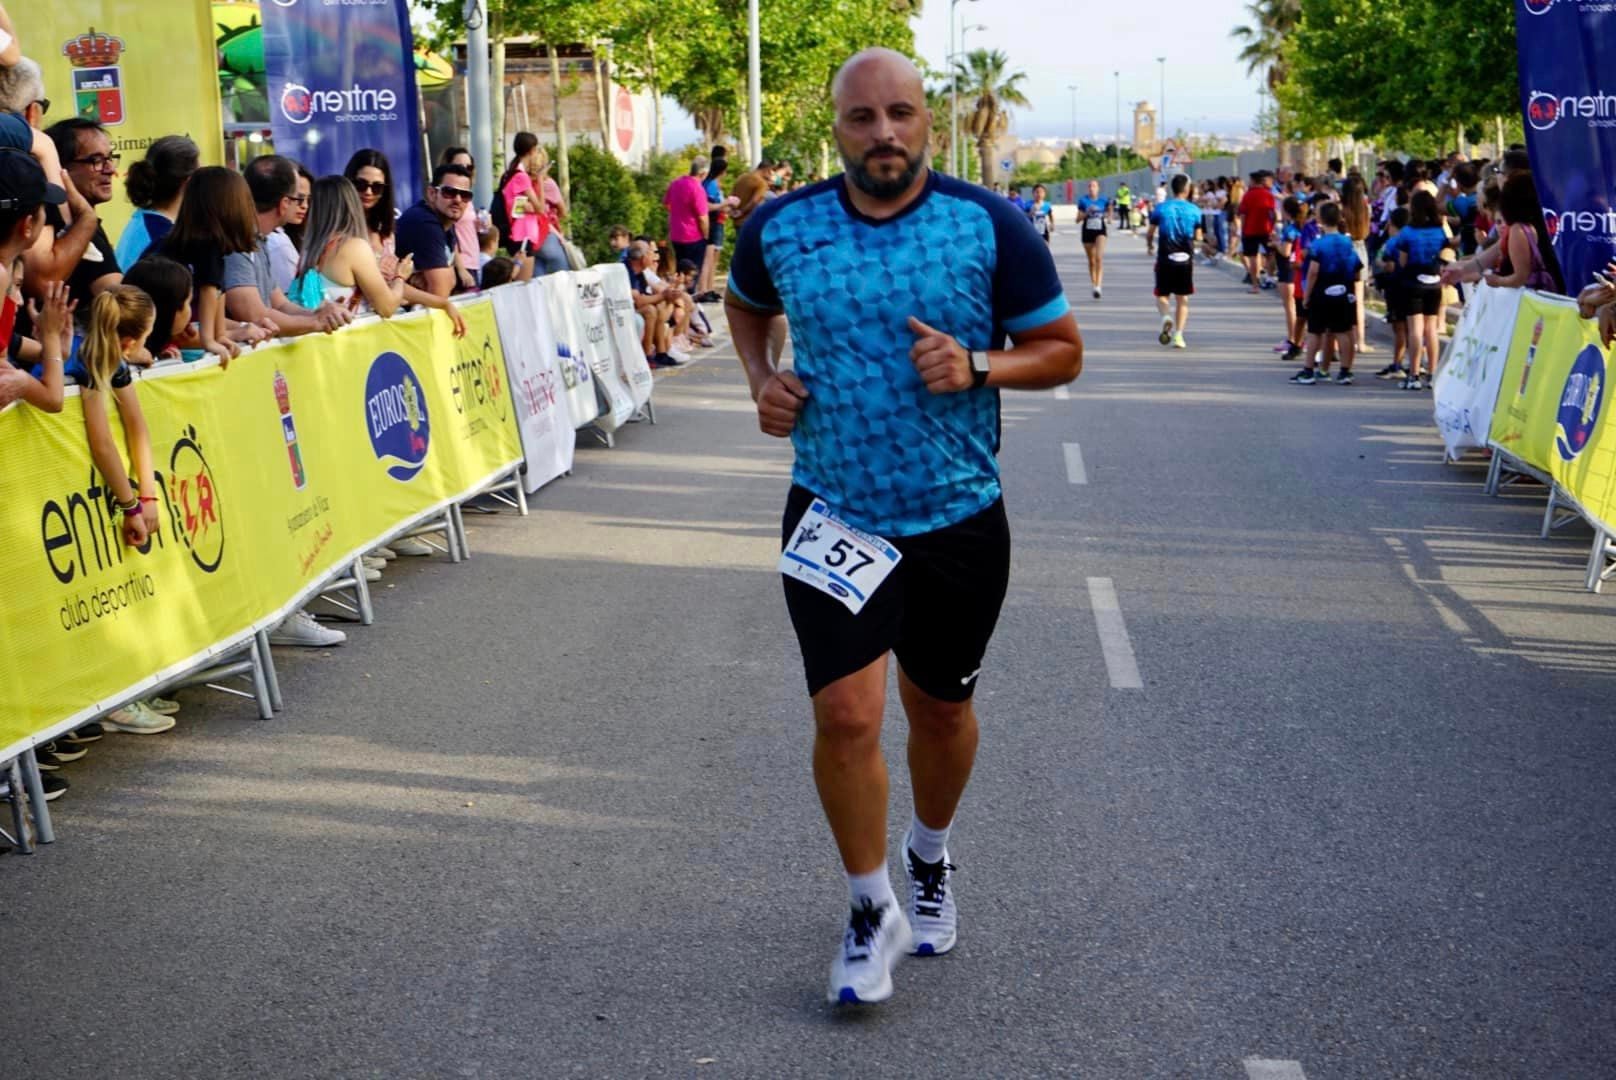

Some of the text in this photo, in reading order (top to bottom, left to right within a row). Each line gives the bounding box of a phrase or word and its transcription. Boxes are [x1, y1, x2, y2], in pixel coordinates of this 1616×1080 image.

[367, 383, 425, 439] EUROSL
[825, 538, 875, 577] 57
[60, 572, 155, 631] club deportivo
